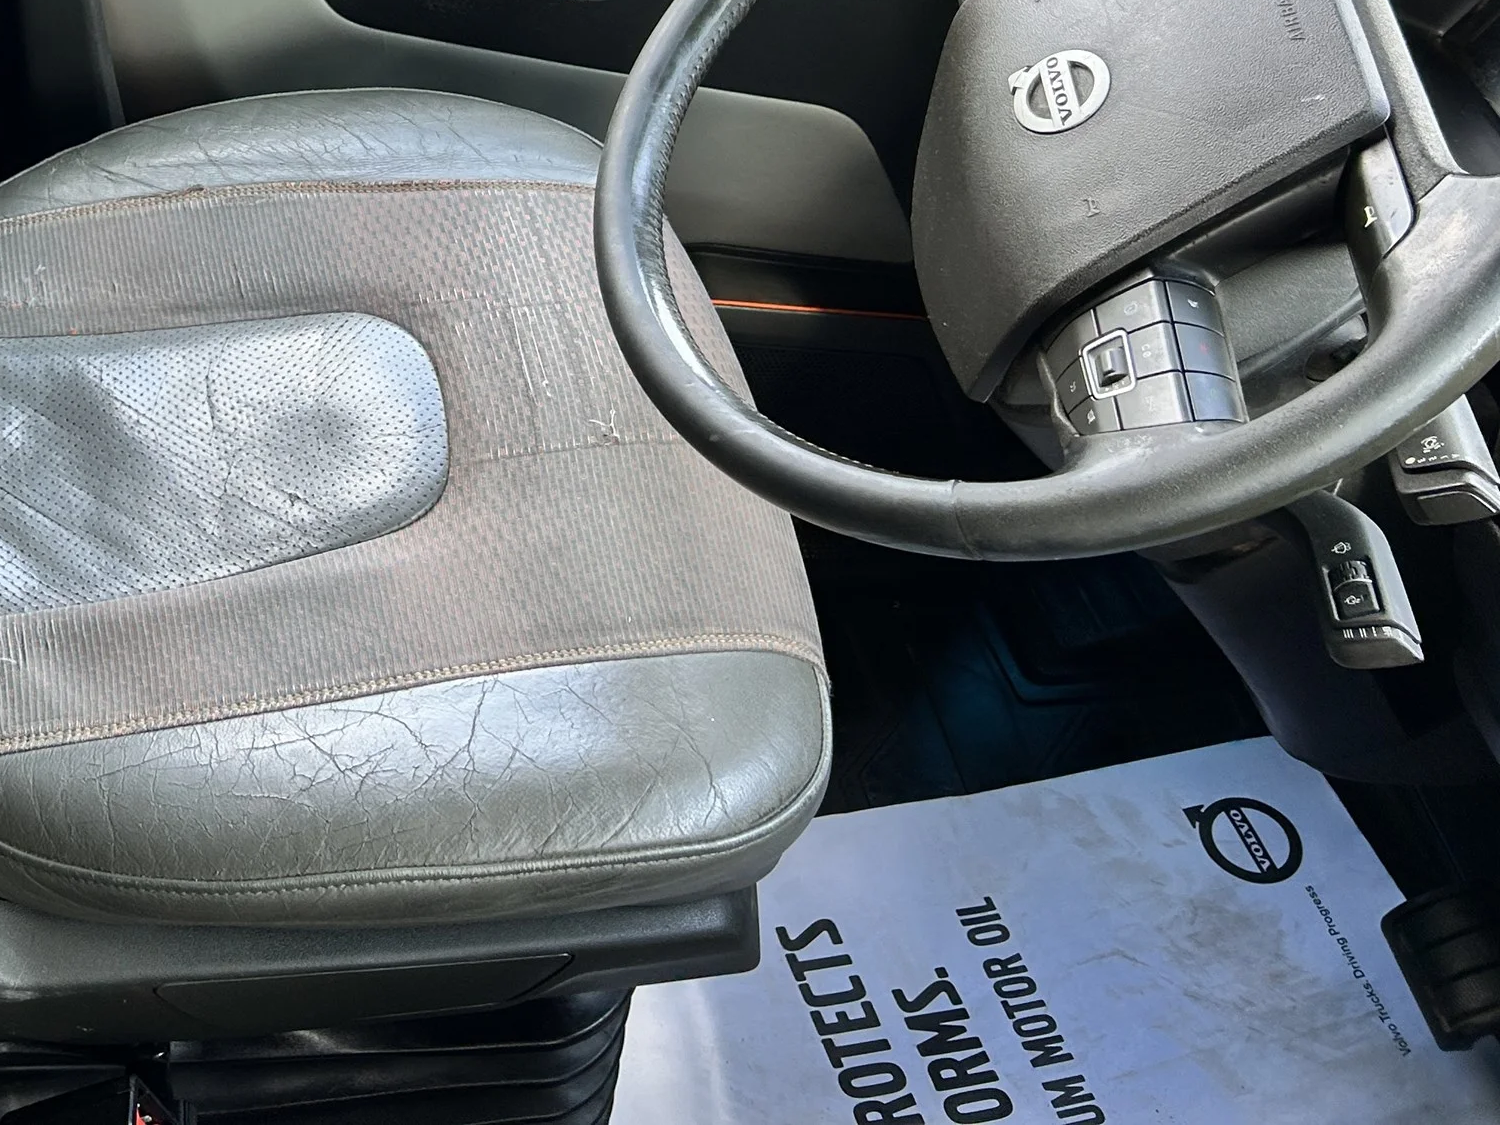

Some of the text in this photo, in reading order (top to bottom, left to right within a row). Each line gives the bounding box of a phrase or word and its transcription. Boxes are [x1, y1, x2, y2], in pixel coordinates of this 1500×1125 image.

[1046, 56, 1073, 126] VOLVO
[1229, 809, 1271, 872] VOLVO
[955, 896, 1011, 947] OIL
[982, 952, 1075, 1068] MOTOR
[1305, 885, 1411, 1057] Volvo Trucks. Driving Progress
[891, 966, 1014, 1125] ORMS.
